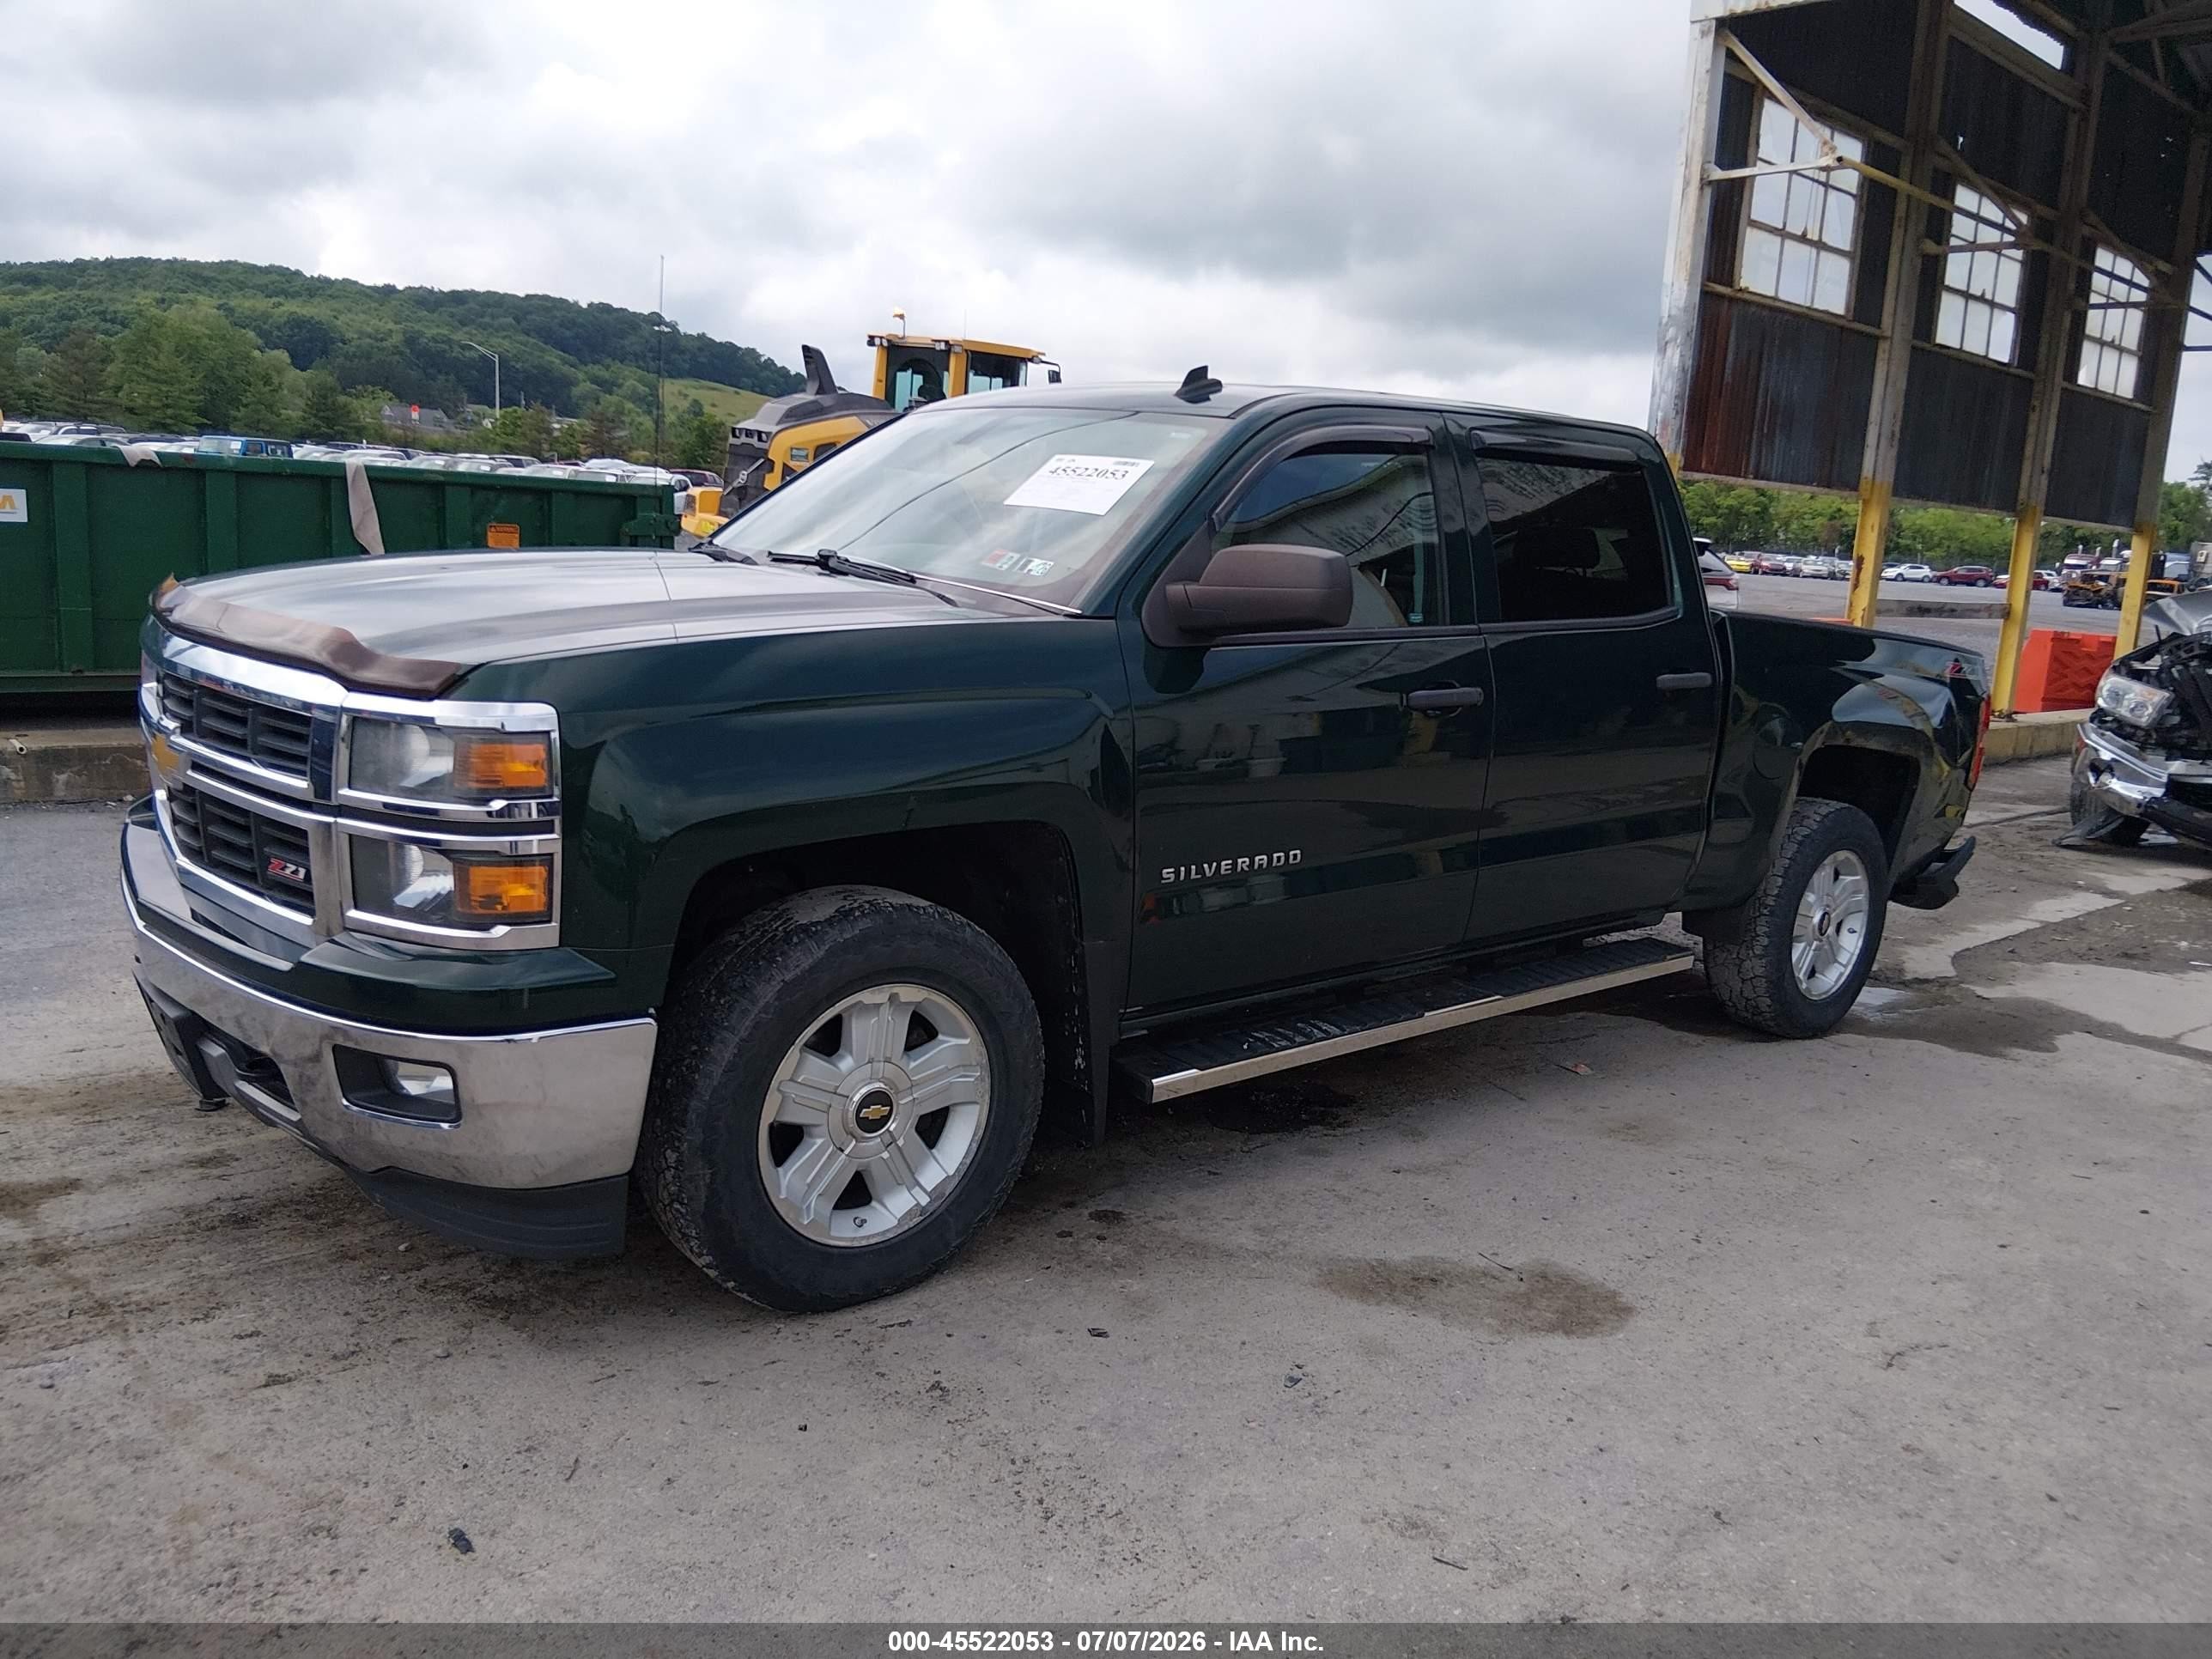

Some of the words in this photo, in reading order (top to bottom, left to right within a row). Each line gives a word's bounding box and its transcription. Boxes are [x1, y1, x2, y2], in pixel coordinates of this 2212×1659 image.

[1048, 466, 1129, 480] 45522053
[268, 858, 307, 881] Z71
[1161, 849, 1302, 884] SILVERADO
